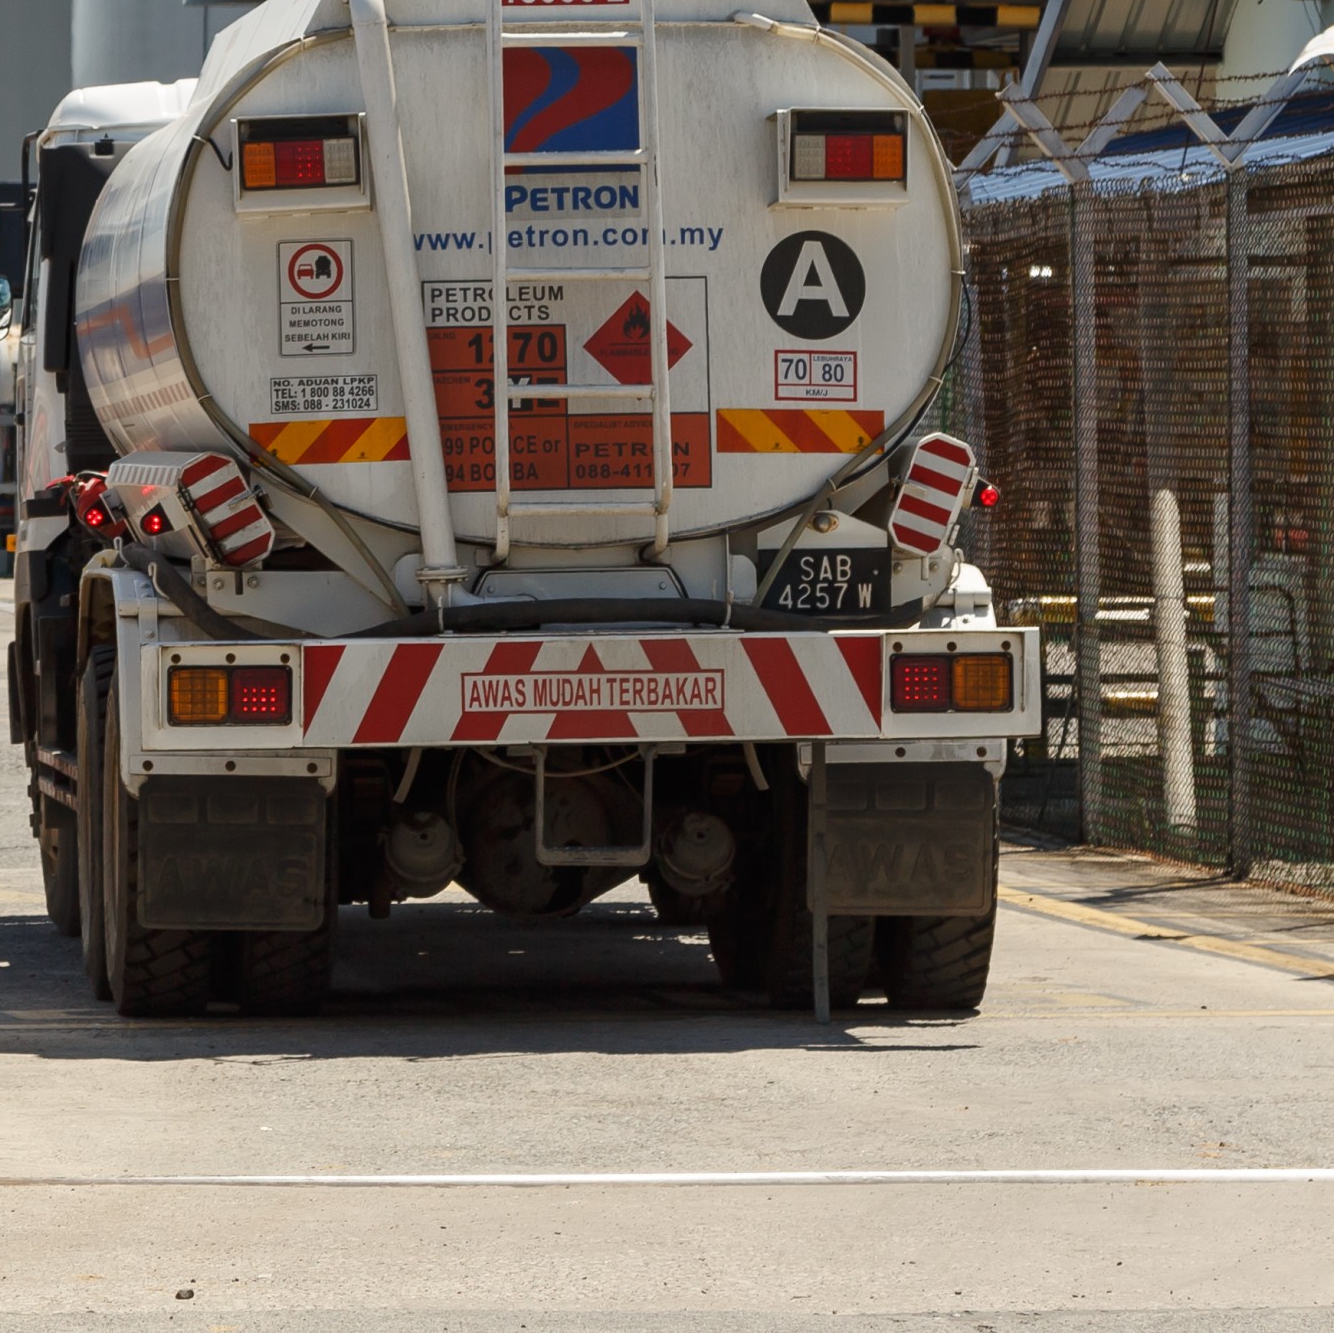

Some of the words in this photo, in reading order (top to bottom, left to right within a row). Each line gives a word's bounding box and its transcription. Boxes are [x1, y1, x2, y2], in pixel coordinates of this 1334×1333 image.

[504, 184, 639, 213] PETRON
[776, 240, 850, 317] A
[290, 306, 301, 315] DI
[302, 305, 343, 315] LARANG
[431, 305, 551, 323] PRODCTS
[289, 318, 345, 328] MEMOTONG
[284, 332, 329, 343] SEBELAH
[331, 332, 351, 341] KIRI
[812, 355, 853, 363] LEBUHRAYA
[780, 358, 808, 381] 70
[821, 363, 845, 383] 80
[273, 379, 294, 387] NO.
[297, 378, 339, 387] ADUAN
[342, 376, 375, 386] LPKP
[273, 388, 298, 400] TEL:
[300, 387, 307, 399] 1
[310, 386, 330, 398] 800
[332, 386, 346, 398] 88
[348, 385, 375, 397] 4266
[805, 388, 829, 397] KM/J
[274, 400, 300, 412] SMS:
[303, 398, 323, 410] 088
[331, 397, 371, 410] 231024
[542, 438, 561, 454] or
[573, 441, 691, 459] PETRN
[470, 462, 539, 482] BOBA
[800, 554, 852, 582] SAB
[778, 583, 849, 609] 4257
[857, 583, 873, 609] W
[468, 678, 527, 708] AWAS
[533, 677, 601, 707] MUDAH
[606, 676, 718, 707] TERBAKAR
